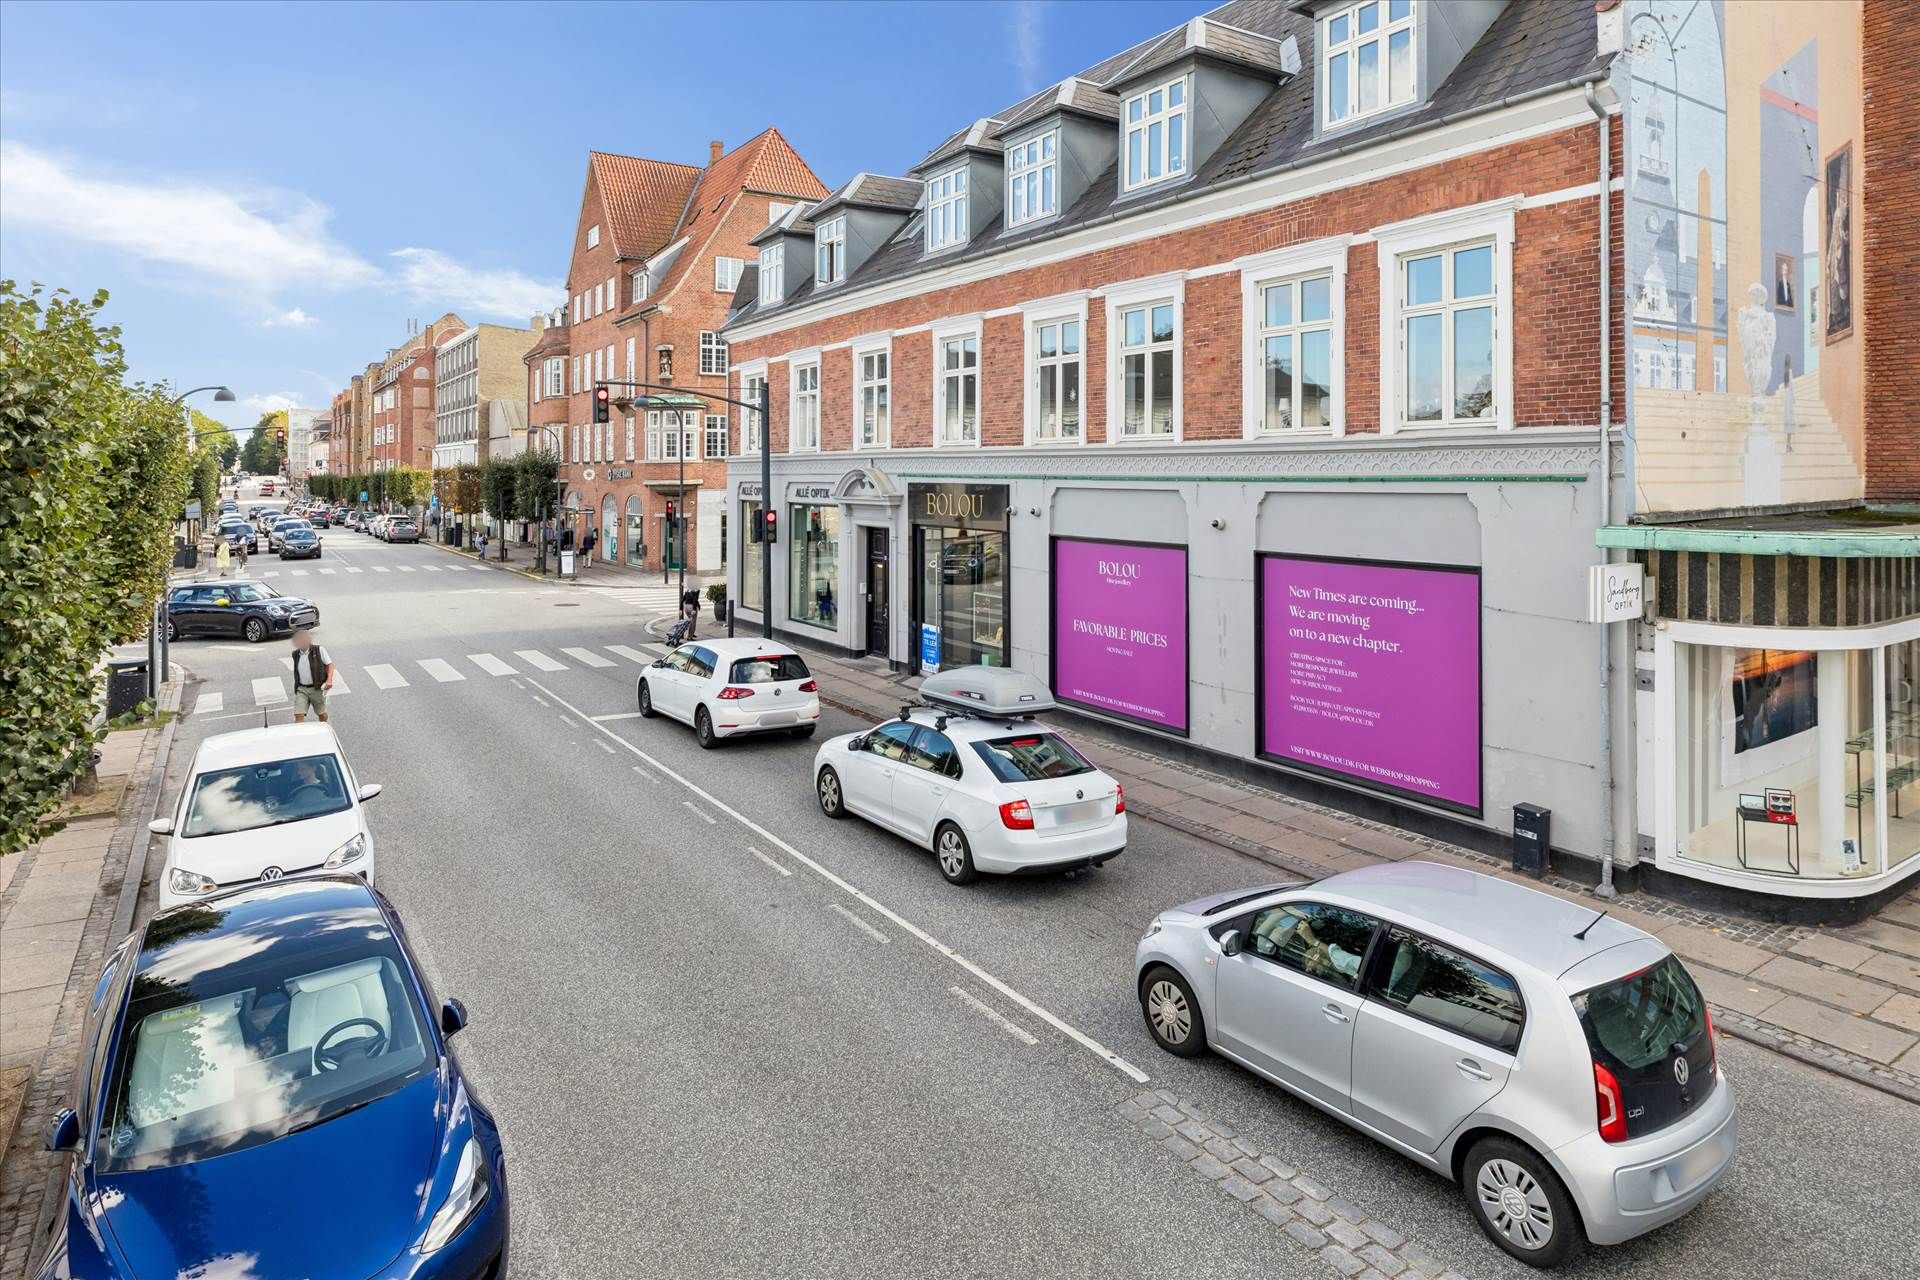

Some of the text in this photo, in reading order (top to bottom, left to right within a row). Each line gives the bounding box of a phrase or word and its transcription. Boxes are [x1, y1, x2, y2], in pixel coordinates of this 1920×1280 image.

[795, 486, 830, 499] ALLÉ OPTIK
[926, 493, 984, 518] BOLOU
[1099, 560, 1141, 579] BOLOU
[1289, 585, 1425, 615] New Times are coming...
[1607, 575, 1640, 603] Sandberg
[1289, 605, 1370, 631] We are moving
[1615, 600, 1632, 611] OPTIK
[1073, 619, 1168, 648] FAVORABLE PRICES
[1289, 627, 1404, 653] on to a new chapter.
[1290, 745, 1305, 755] VISIT
[1355, 760, 1370, 772] FOR
[1370, 765, 1403, 780] WEBSHOP
[1403, 774, 1440, 790] SHOPPING
